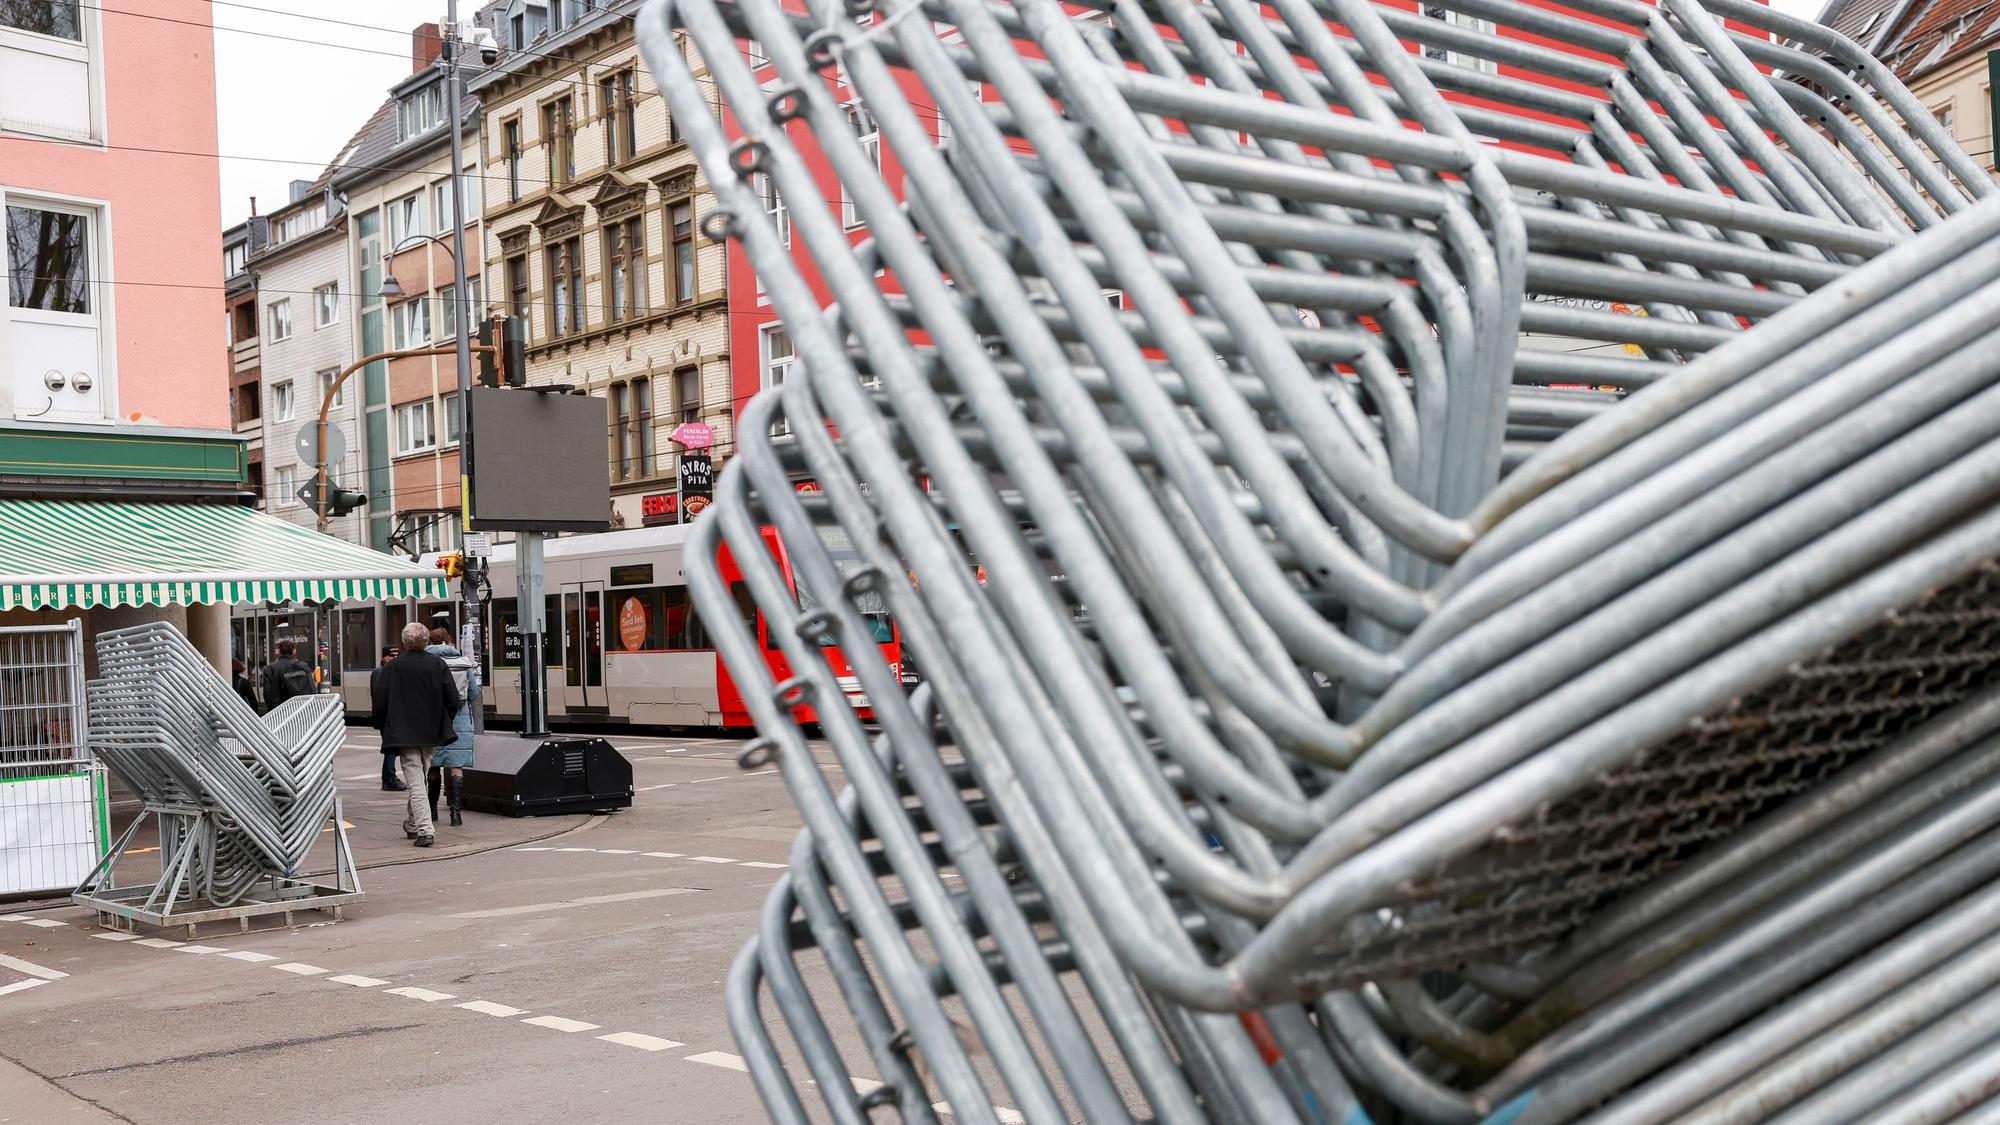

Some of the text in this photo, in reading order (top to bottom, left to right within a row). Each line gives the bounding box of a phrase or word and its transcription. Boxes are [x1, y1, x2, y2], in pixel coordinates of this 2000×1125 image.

[682, 461, 711, 476] GYROS
[688, 476, 707, 485] PITA
[686, 513, 694, 521] PO
[14, 590, 192, 601] BAR KITCHEN
[505, 636, 513, 646] für
